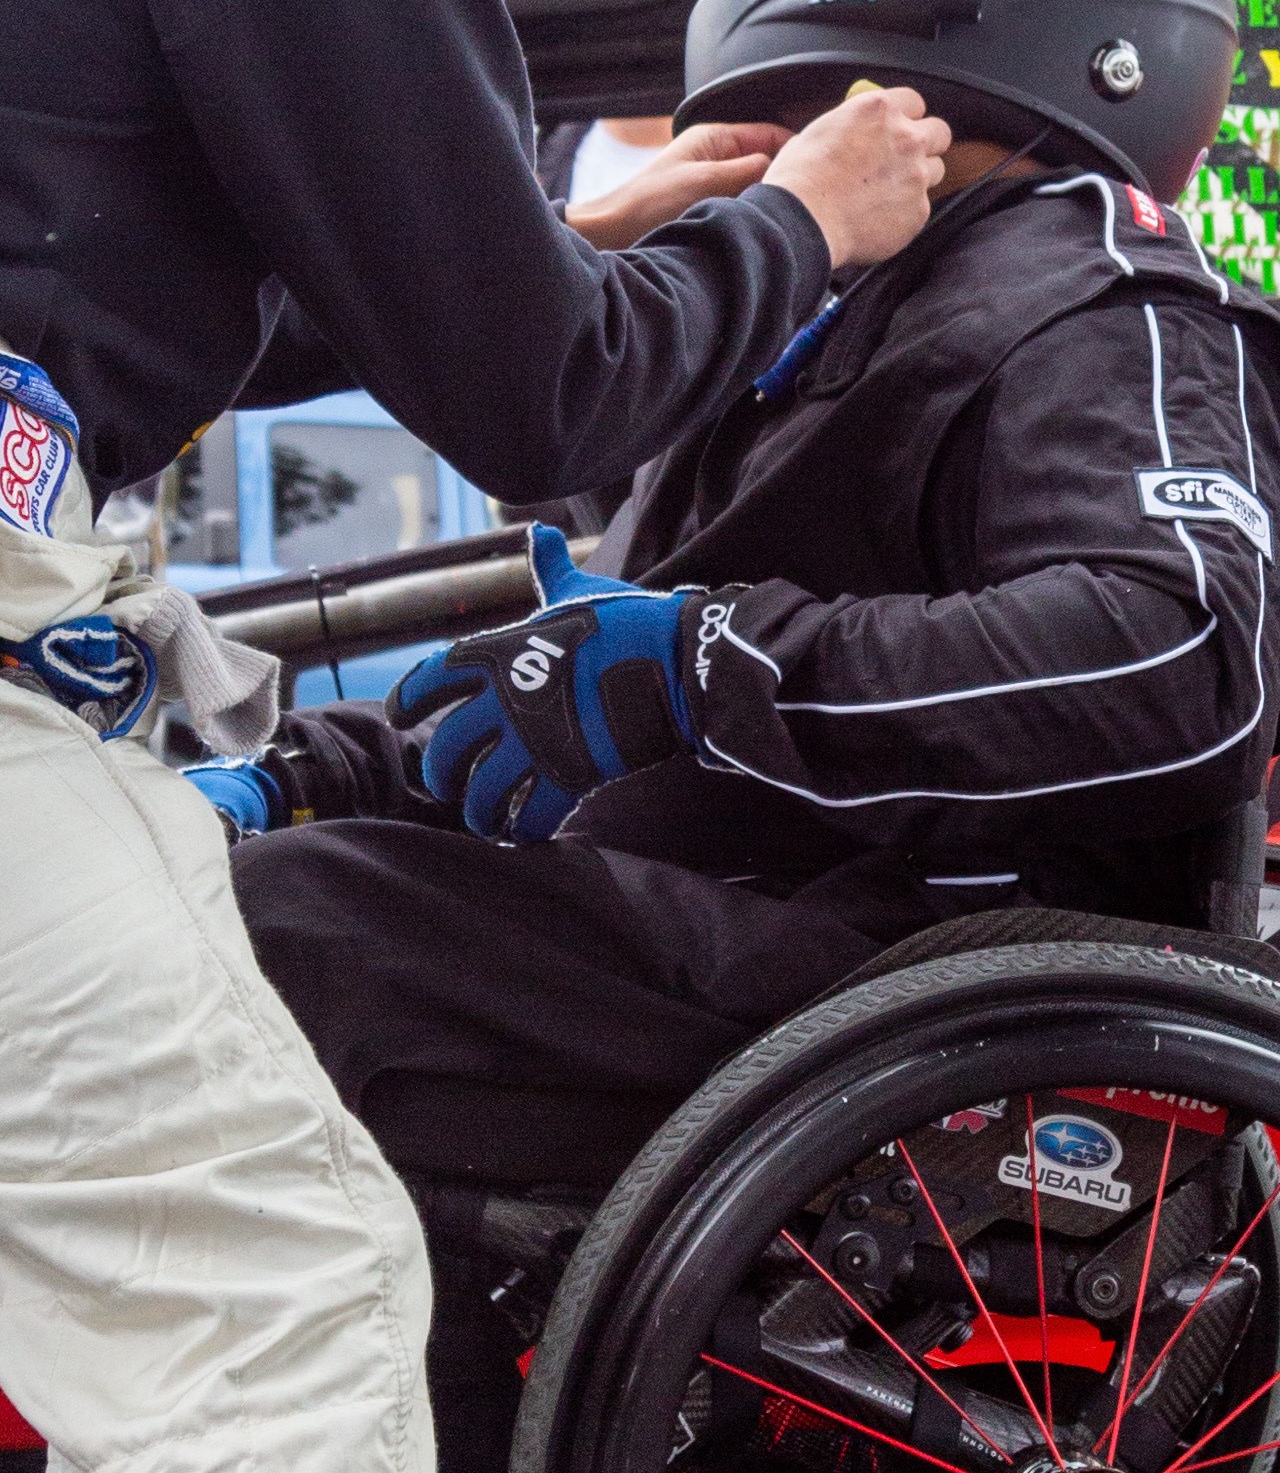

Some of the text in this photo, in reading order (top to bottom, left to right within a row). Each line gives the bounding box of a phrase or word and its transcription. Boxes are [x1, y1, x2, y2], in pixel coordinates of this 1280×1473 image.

[44, 439, 61, 471] CLUB
[33, 469, 51, 497] CAR
[1164, 480, 1205, 502] sfi
[30, 496, 44, 536] PORTS
[1002, 1159, 1127, 1205] SUBARU
